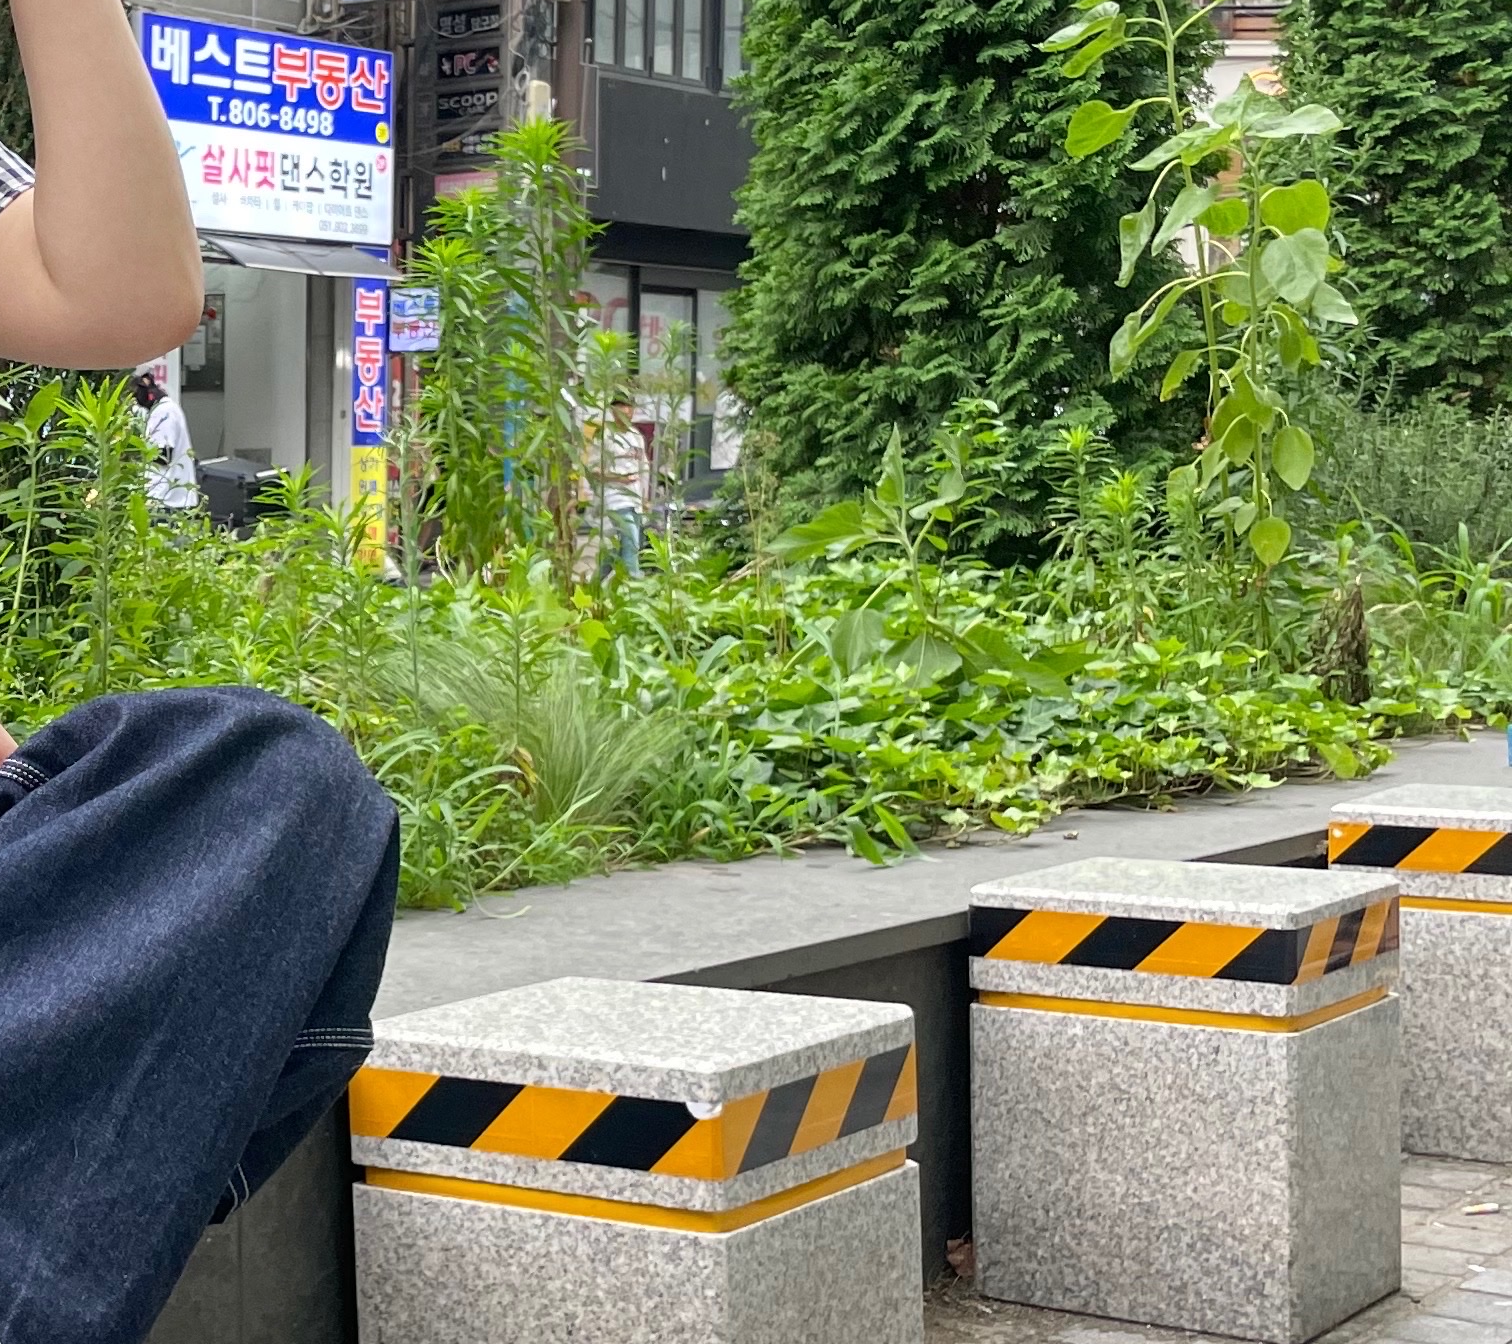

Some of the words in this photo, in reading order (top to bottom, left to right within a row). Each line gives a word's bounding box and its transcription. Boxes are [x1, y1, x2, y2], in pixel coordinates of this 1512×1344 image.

[207, 96, 335, 137] T.806-8498
[438, 92, 498, 110] SCOOP
[354, 287, 385, 434] 부동산
